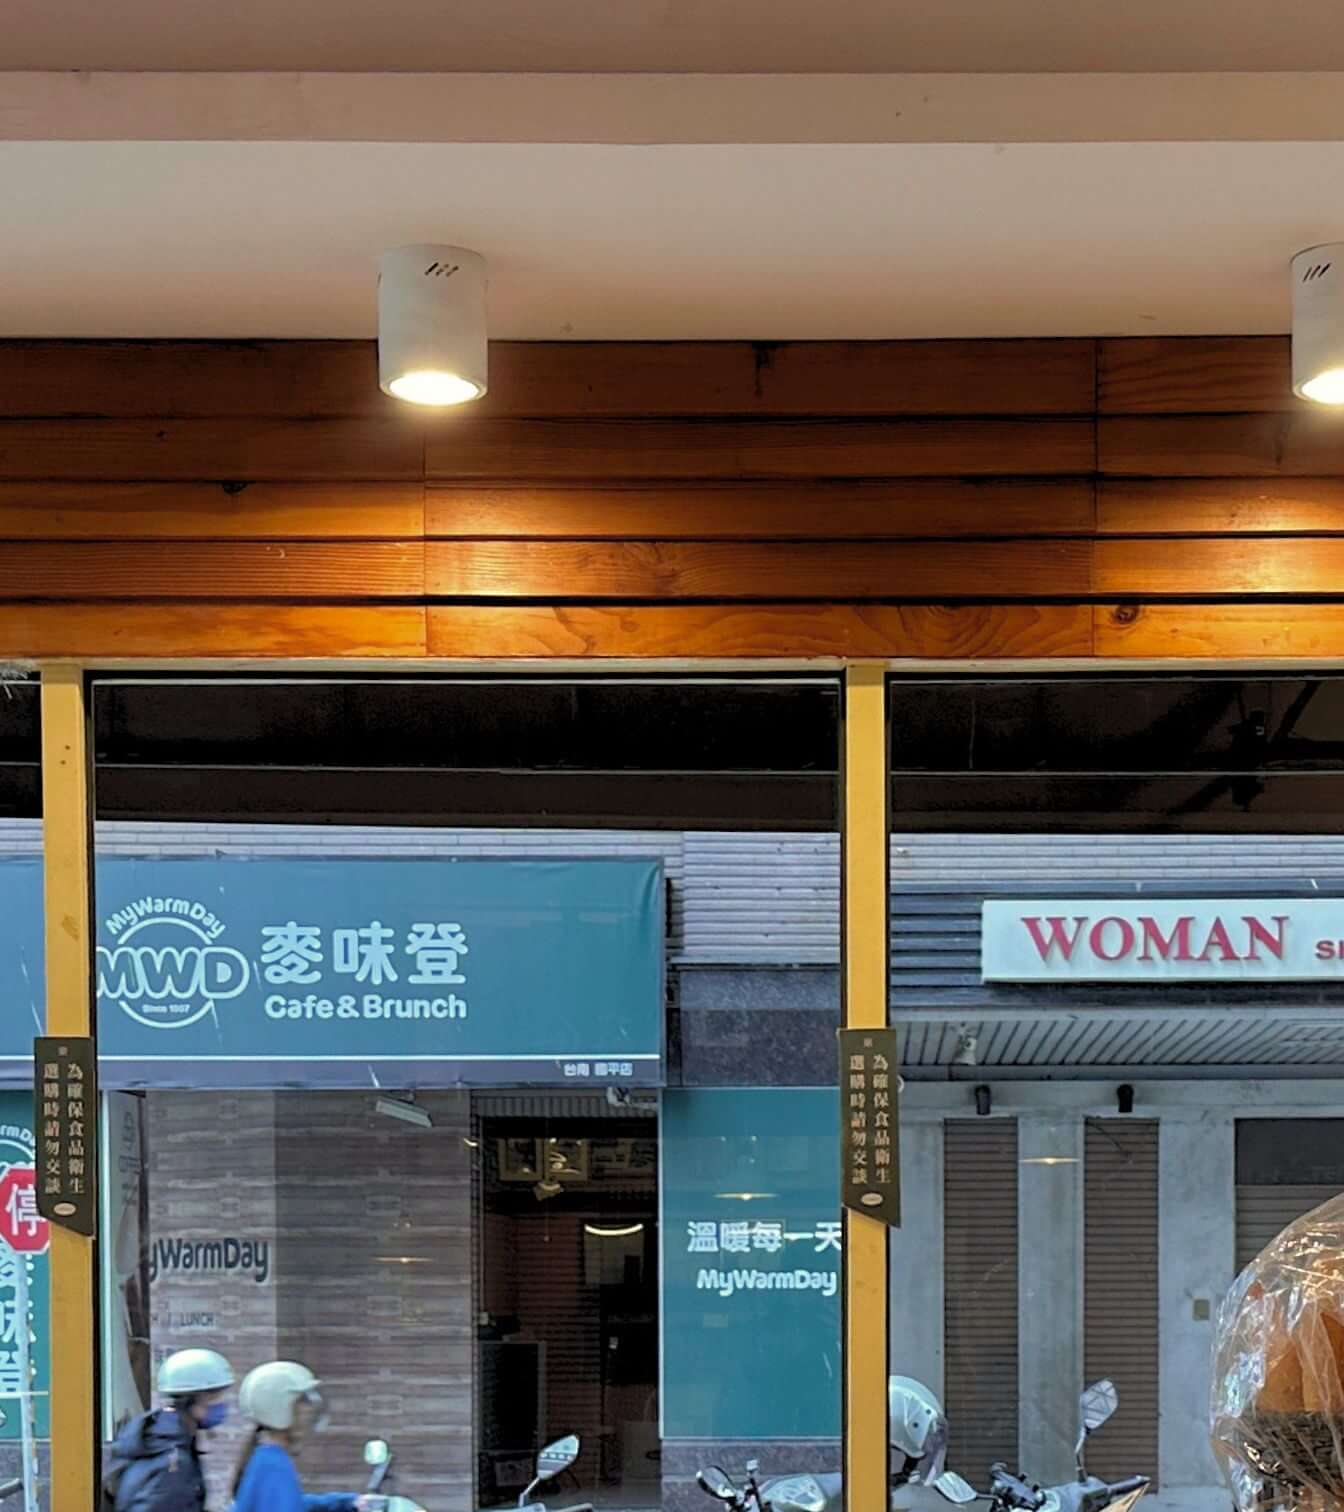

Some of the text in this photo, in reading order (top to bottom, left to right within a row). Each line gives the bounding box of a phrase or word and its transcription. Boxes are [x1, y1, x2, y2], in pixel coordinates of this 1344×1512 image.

[106, 896, 226, 939] MyWarmDay
[1022, 914, 1290, 961] WOMAN
[96, 946, 250, 999] MWD
[261, 921, 468, 985] 麥味登
[44, 1063, 61, 1194] 選購時請勿交談
[67, 1063, 84, 1194] 為確保食品衛生
[850, 1054, 867, 1184] 選購時請勿交談
[873, 1054, 891, 1183] 為確保食品衛生
[6, 1182, 42, 1236] 停
[150, 1236, 268, 1283] yWarmDay
[697, 1269, 837, 1296] MyWarmDay
